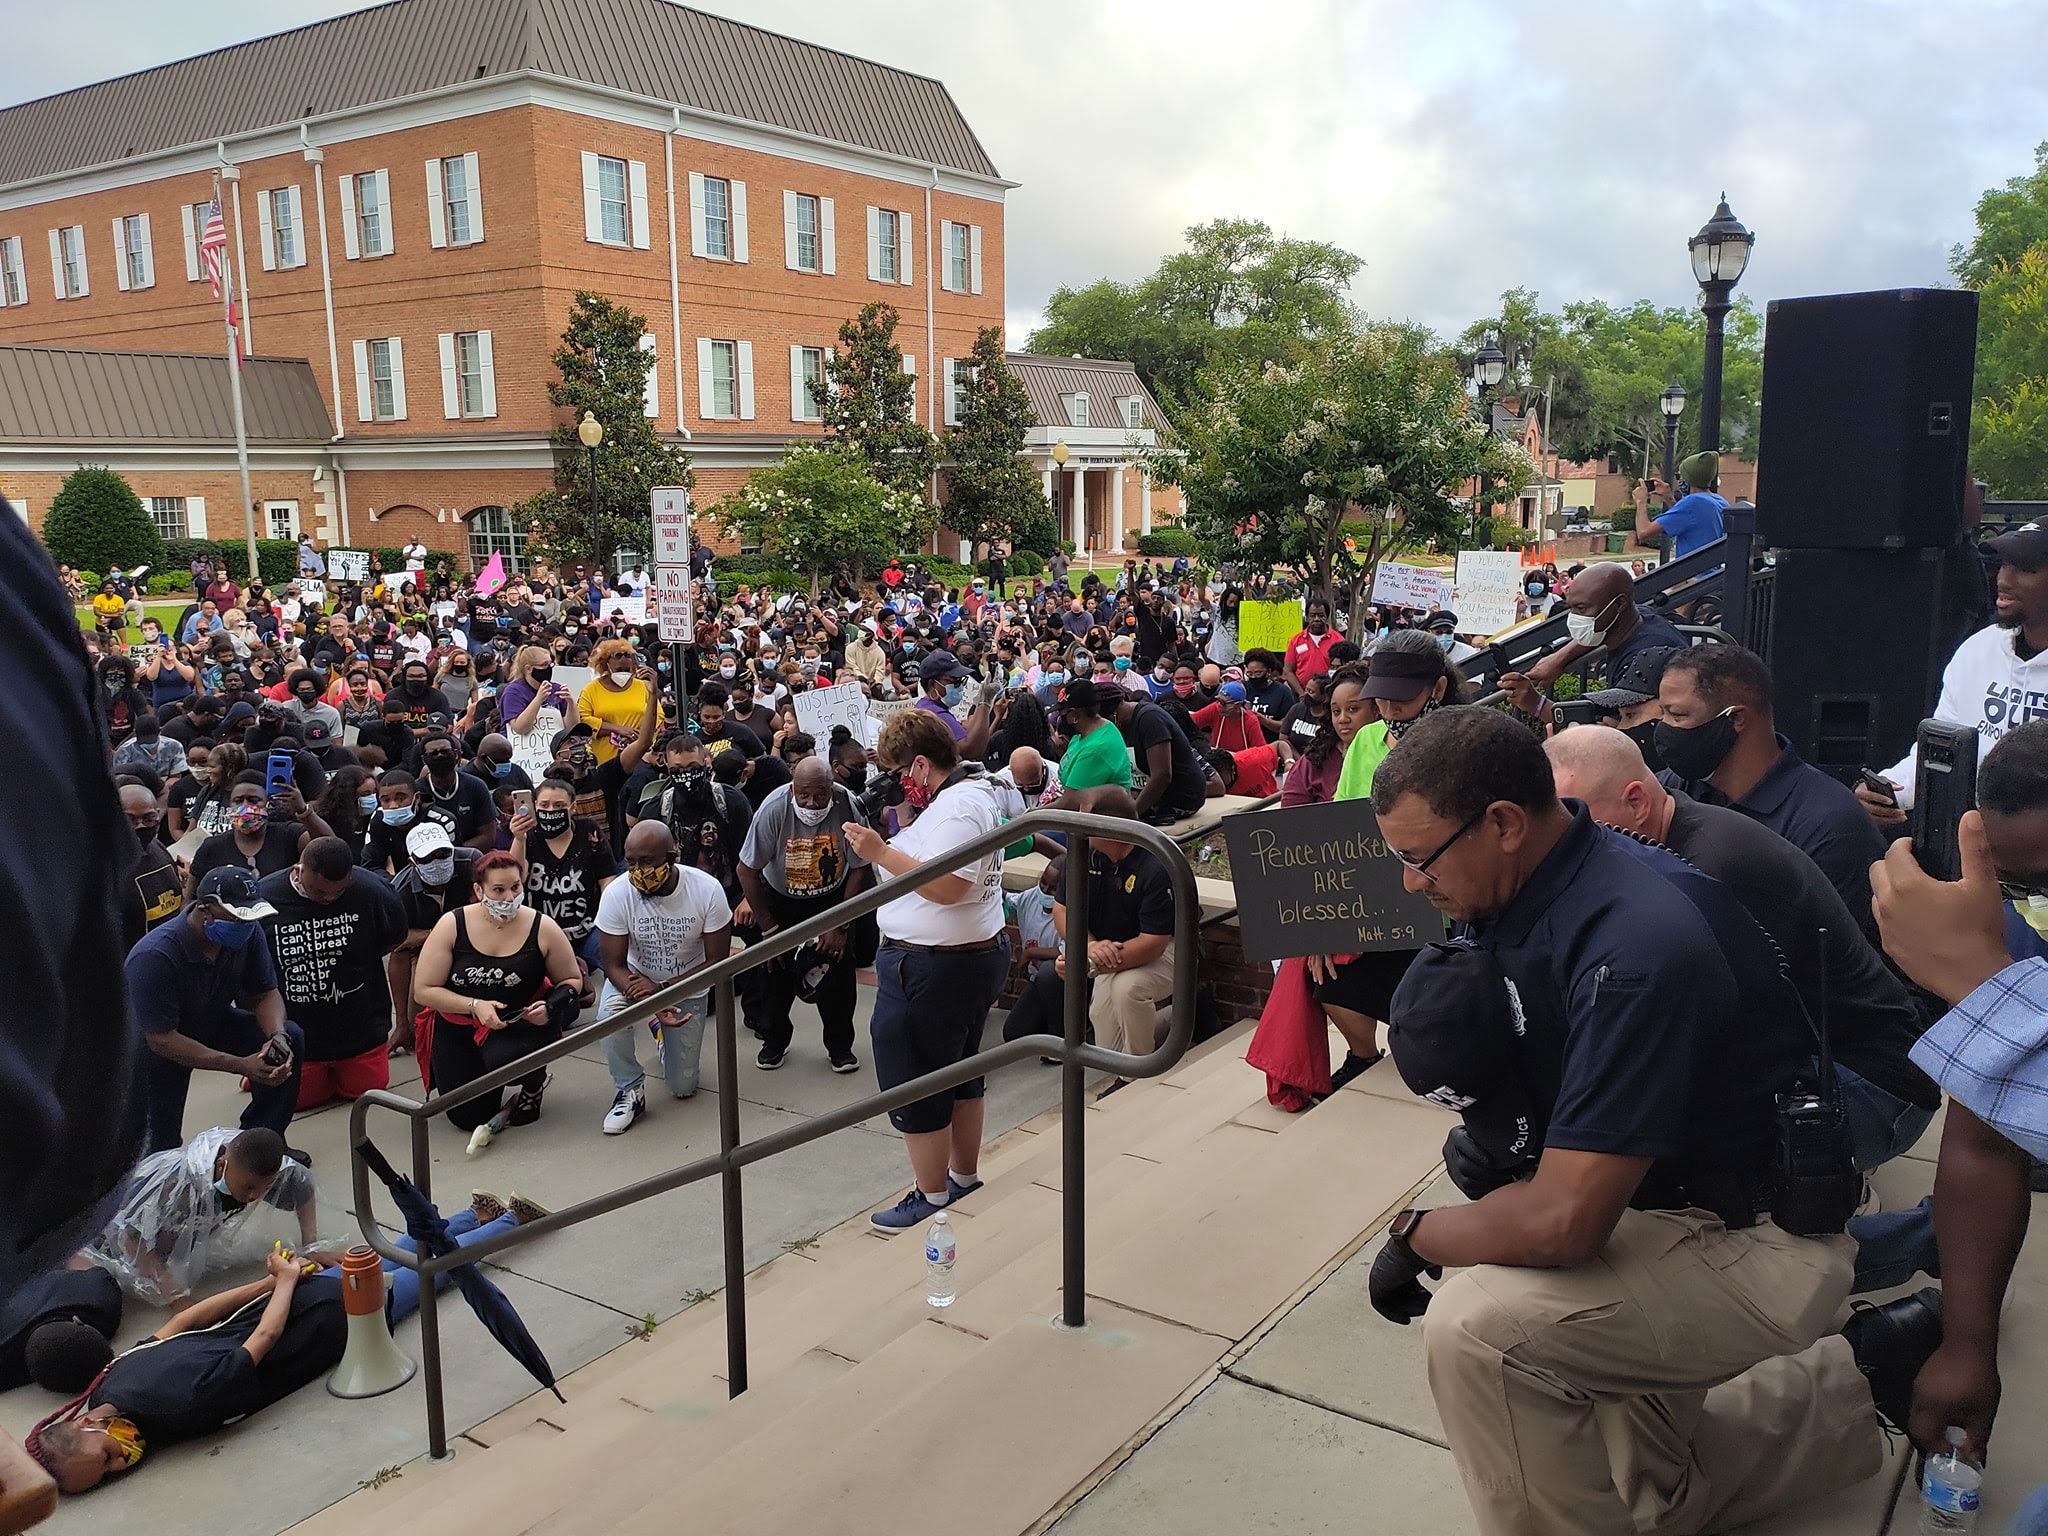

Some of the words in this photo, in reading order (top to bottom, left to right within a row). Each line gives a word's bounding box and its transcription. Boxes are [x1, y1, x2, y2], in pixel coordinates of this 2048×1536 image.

[664, 500, 673, 510] LAW
[656, 514, 683, 524] ENFORCEMENT
[662, 527, 679, 538] PARKING
[666, 542, 676, 551] ONLY
[667, 573, 680, 587] NO
[659, 589, 688, 604] PARKING
[663, 607, 688, 616] UNAUTHORIZED
[796, 682, 859, 713] JUSTICE
[1252, 704, 1269, 713] N'T
[403, 711, 429, 723] BLAC
[817, 709, 835, 724] for
[1292, 718, 1321, 737] EQUAL
[1977, 719, 2003, 740] EMPO
[545, 811, 565, 820] Justice
[528, 862, 586, 895] BLACK
[1313, 868, 1356, 894] ARE
[788, 888, 806, 896] U.S.
[280, 920, 310, 934] can't
[313, 912, 359, 928] breathe
[639, 916, 659, 924] can't
[563, 916, 595, 941] TER
[662, 924, 691, 932] breath
[1391, 925, 1415, 940] 5:9
[282, 931, 311, 945] can't
[314, 924, 353, 940] breath
[282, 942, 312, 956] can't
[315, 936, 347, 950] breat
[317, 958, 336, 968] bre
[290, 971, 316, 981] can't
[318, 969, 330, 979] br
[290, 981, 317, 992] can't
[319, 980, 327, 990] b
[290, 992, 318, 1002] can't
[1509, 1116, 1529, 1154] POLICE
